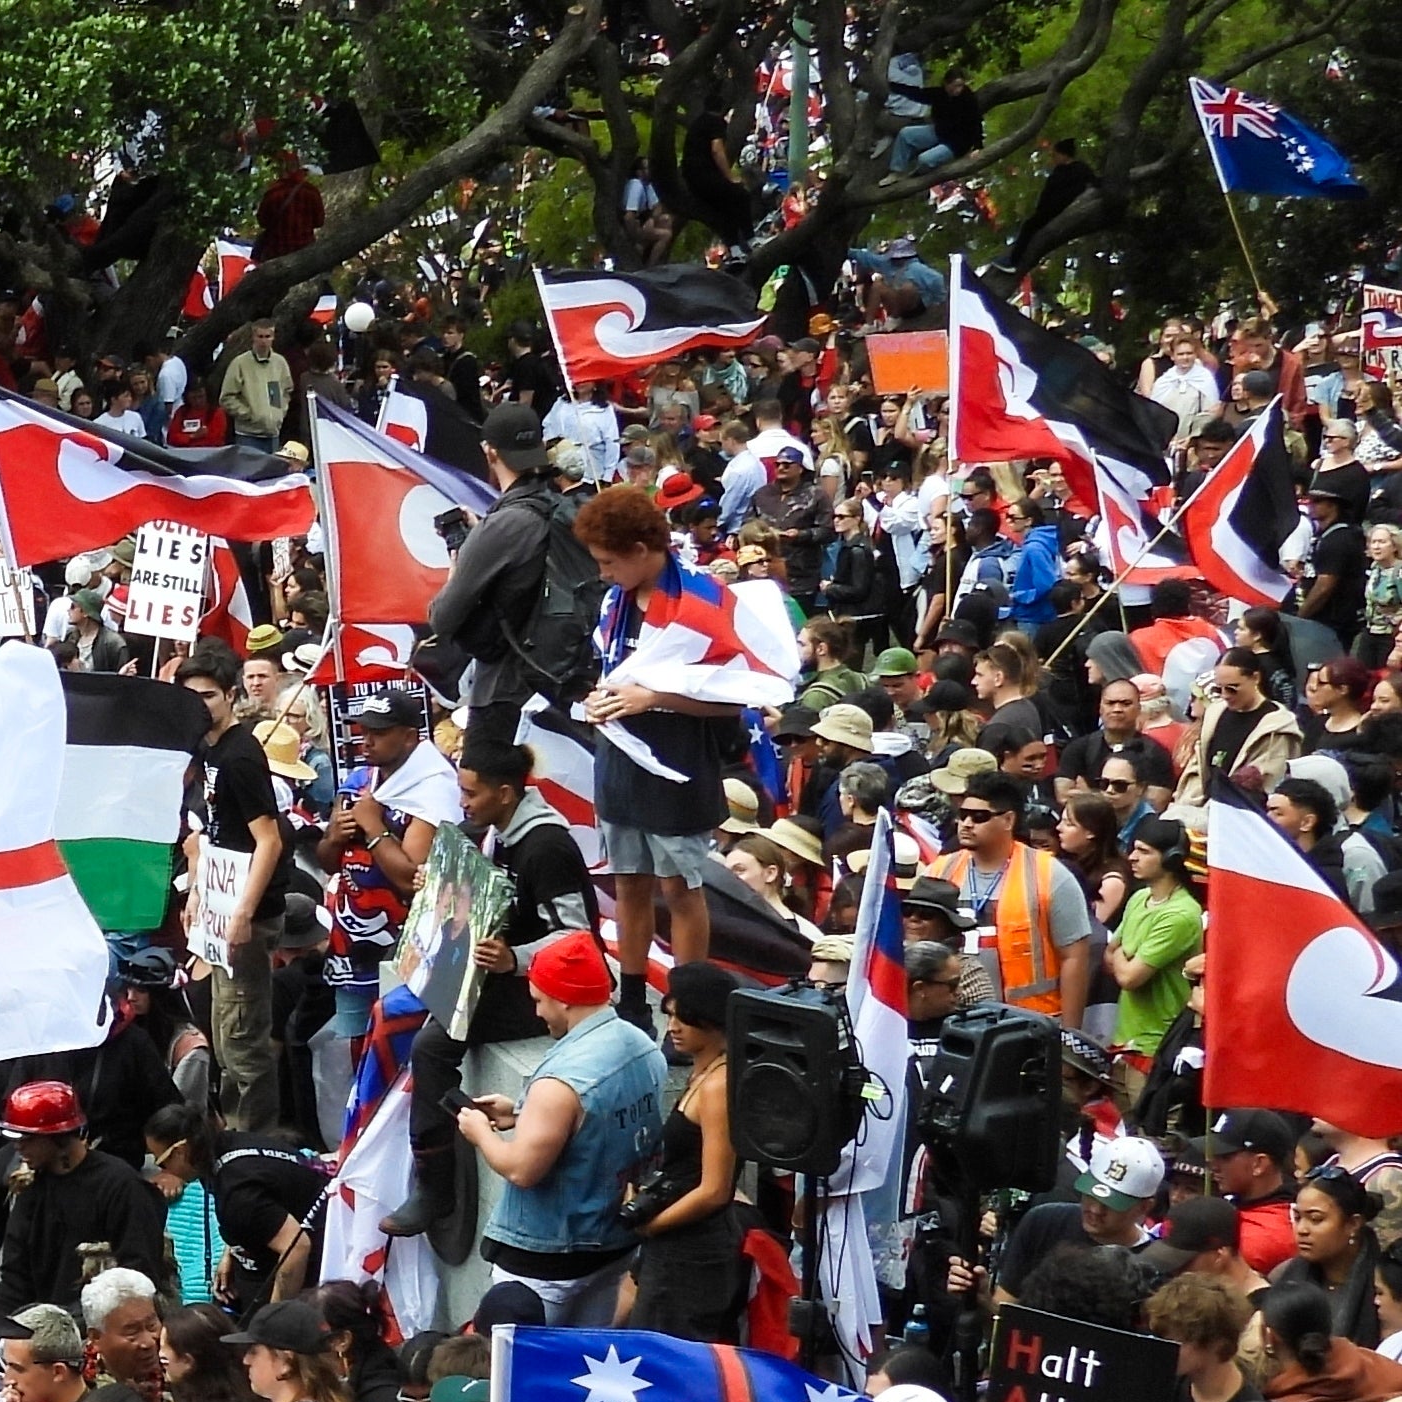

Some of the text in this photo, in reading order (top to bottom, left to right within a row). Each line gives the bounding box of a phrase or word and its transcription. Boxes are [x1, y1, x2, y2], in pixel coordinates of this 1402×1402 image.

[138, 534, 202, 564] LIES
[132, 569, 200, 594] ARE STILL
[128, 599, 194, 626] LIES
[1007, 1328, 1102, 1388] Halt
